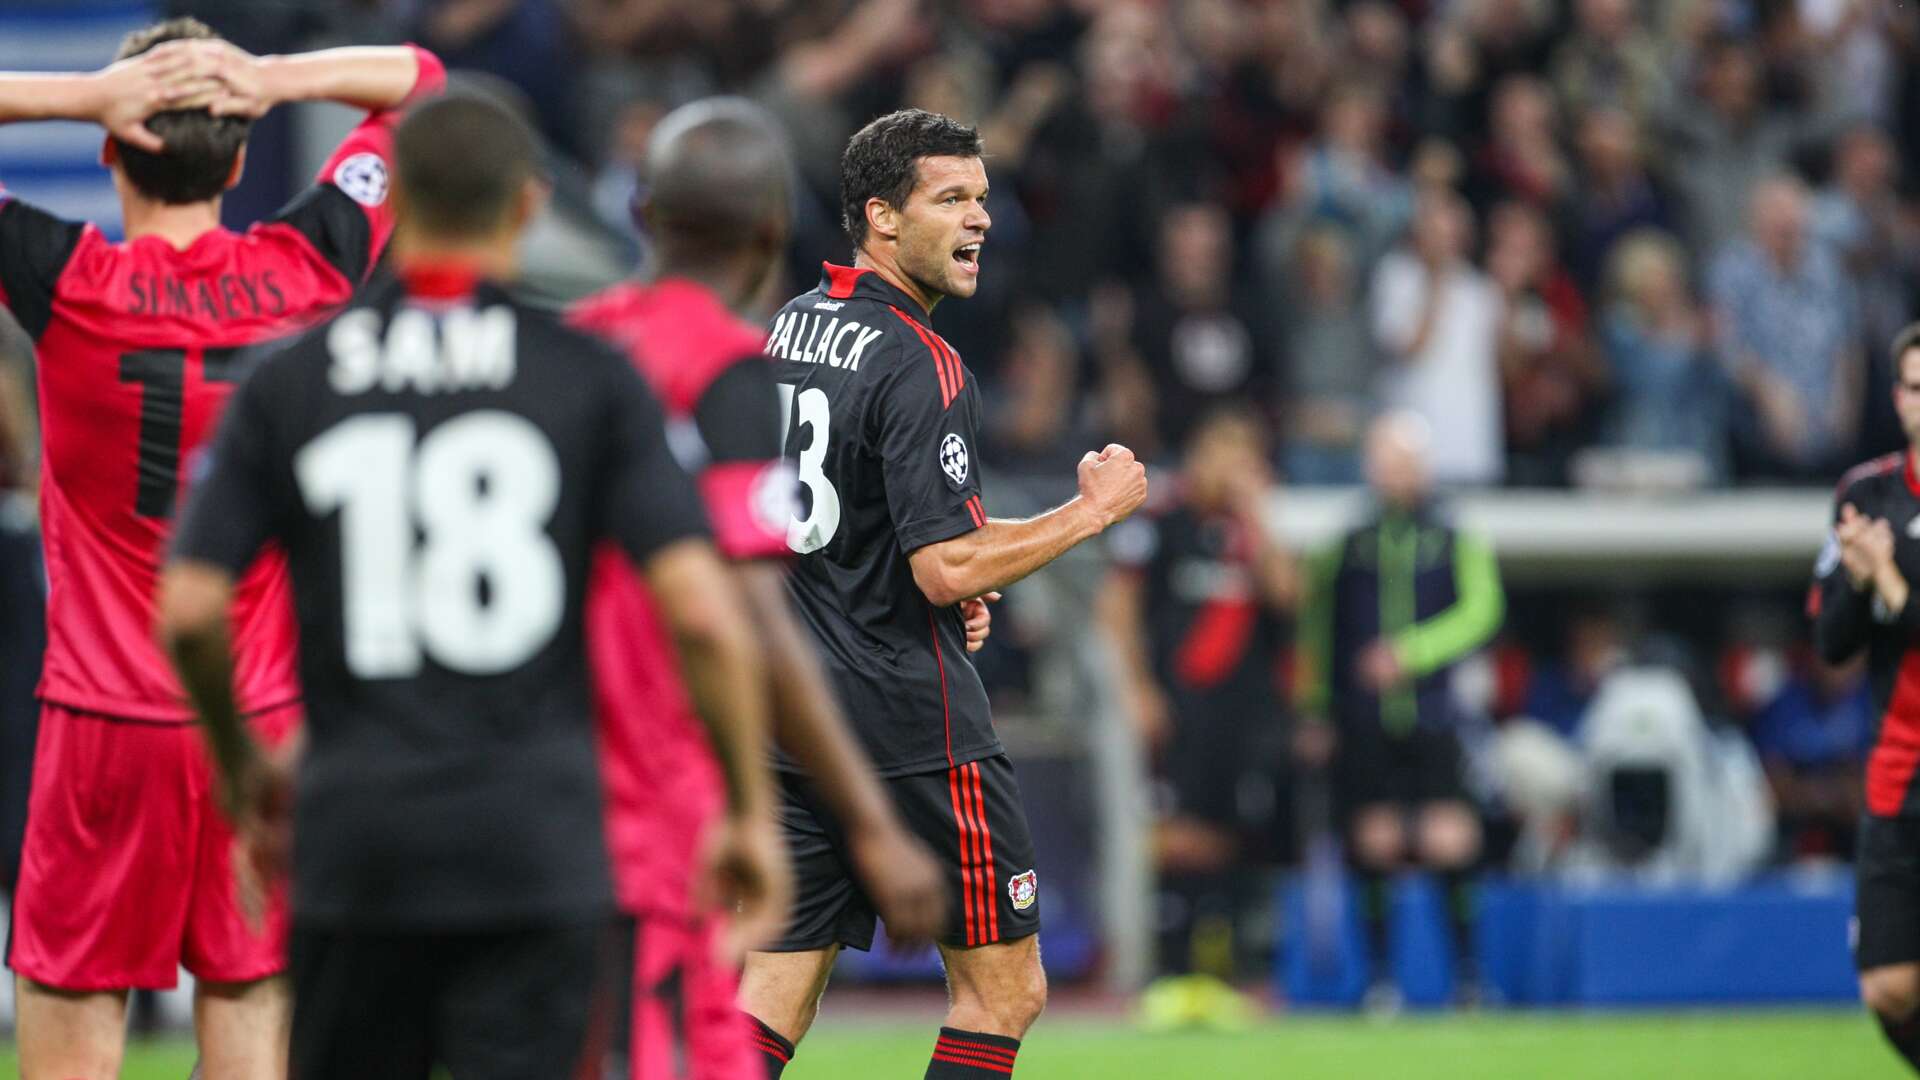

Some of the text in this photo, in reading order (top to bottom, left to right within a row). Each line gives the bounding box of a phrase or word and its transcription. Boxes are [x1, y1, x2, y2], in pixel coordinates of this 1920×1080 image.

[129, 271, 286, 321] SIMAEYS
[328, 306, 516, 394] SAM
[294, 409, 566, 678] 18
